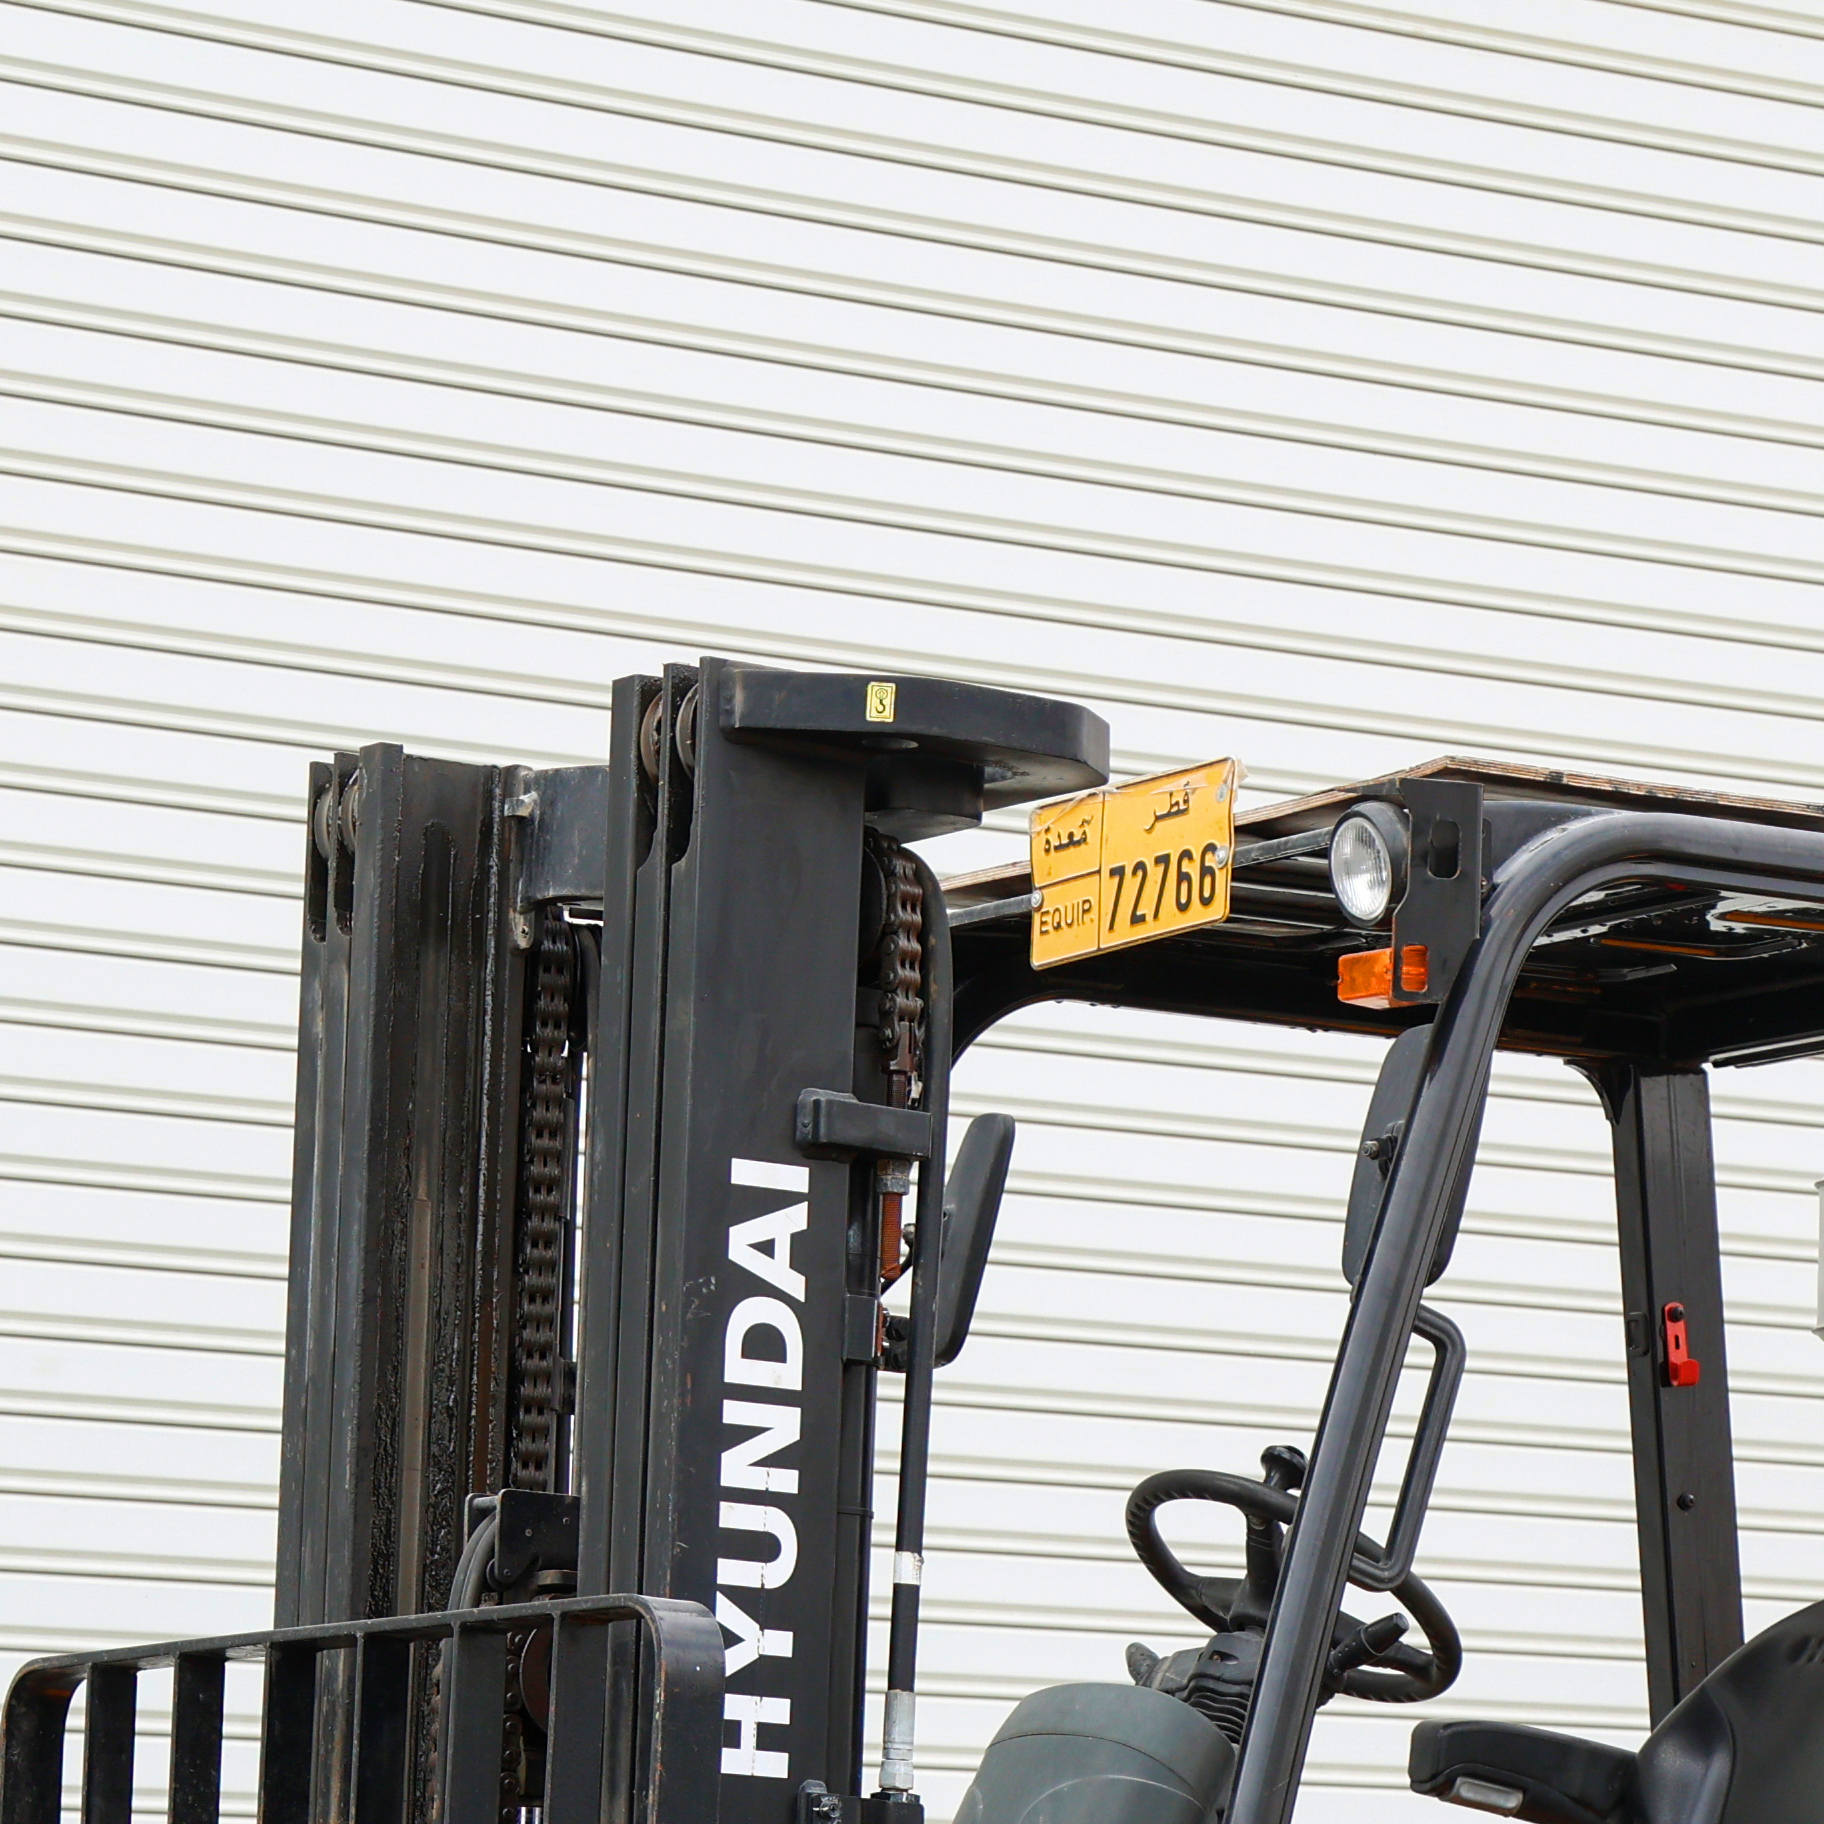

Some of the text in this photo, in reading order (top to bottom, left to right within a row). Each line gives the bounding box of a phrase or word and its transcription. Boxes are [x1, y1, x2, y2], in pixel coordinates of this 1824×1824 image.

[1144, 782, 1192, 833] قطر
[1040, 899, 1095, 935] EQUIP.
[1108, 842, 1219, 933] 72766
[717, 1157, 810, 1779] HYUNDAI
